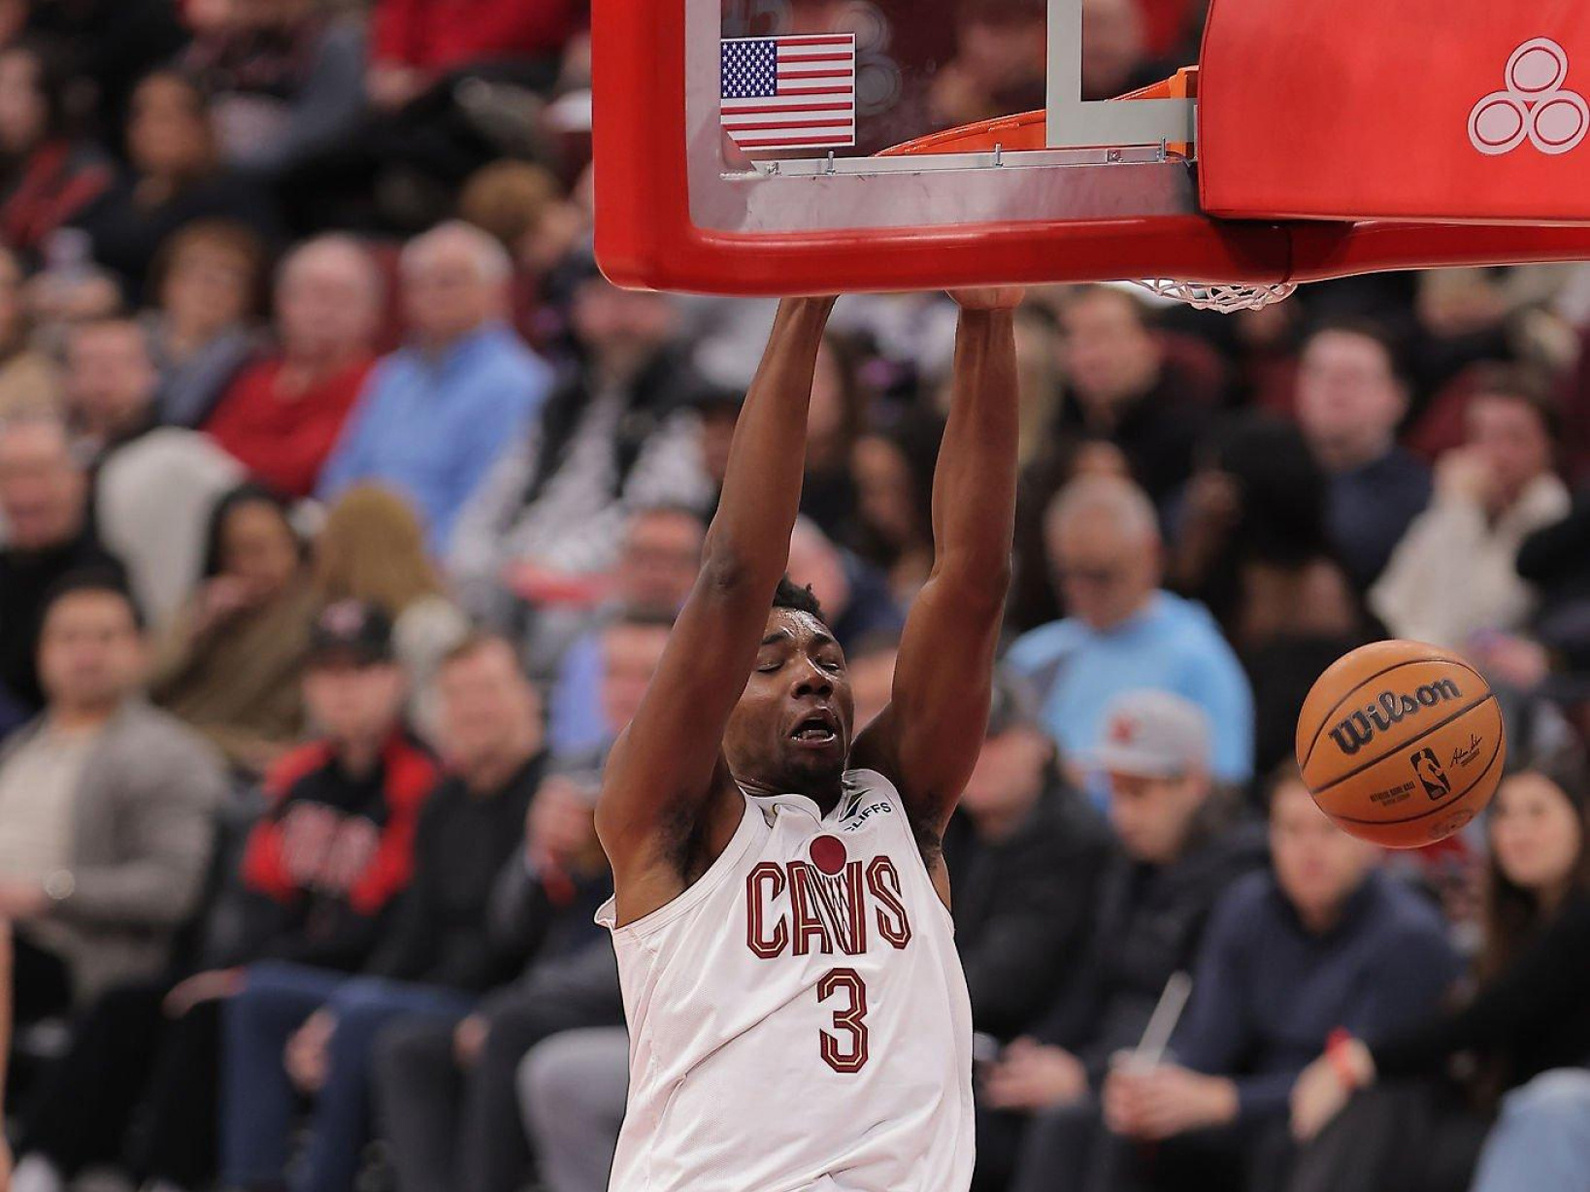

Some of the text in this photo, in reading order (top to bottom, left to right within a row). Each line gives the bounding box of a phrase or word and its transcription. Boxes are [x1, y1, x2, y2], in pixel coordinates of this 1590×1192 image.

[1328, 678, 1462, 756] Wilson
[746, 855, 912, 959] CAVS
[816, 967, 869, 1074] 3
